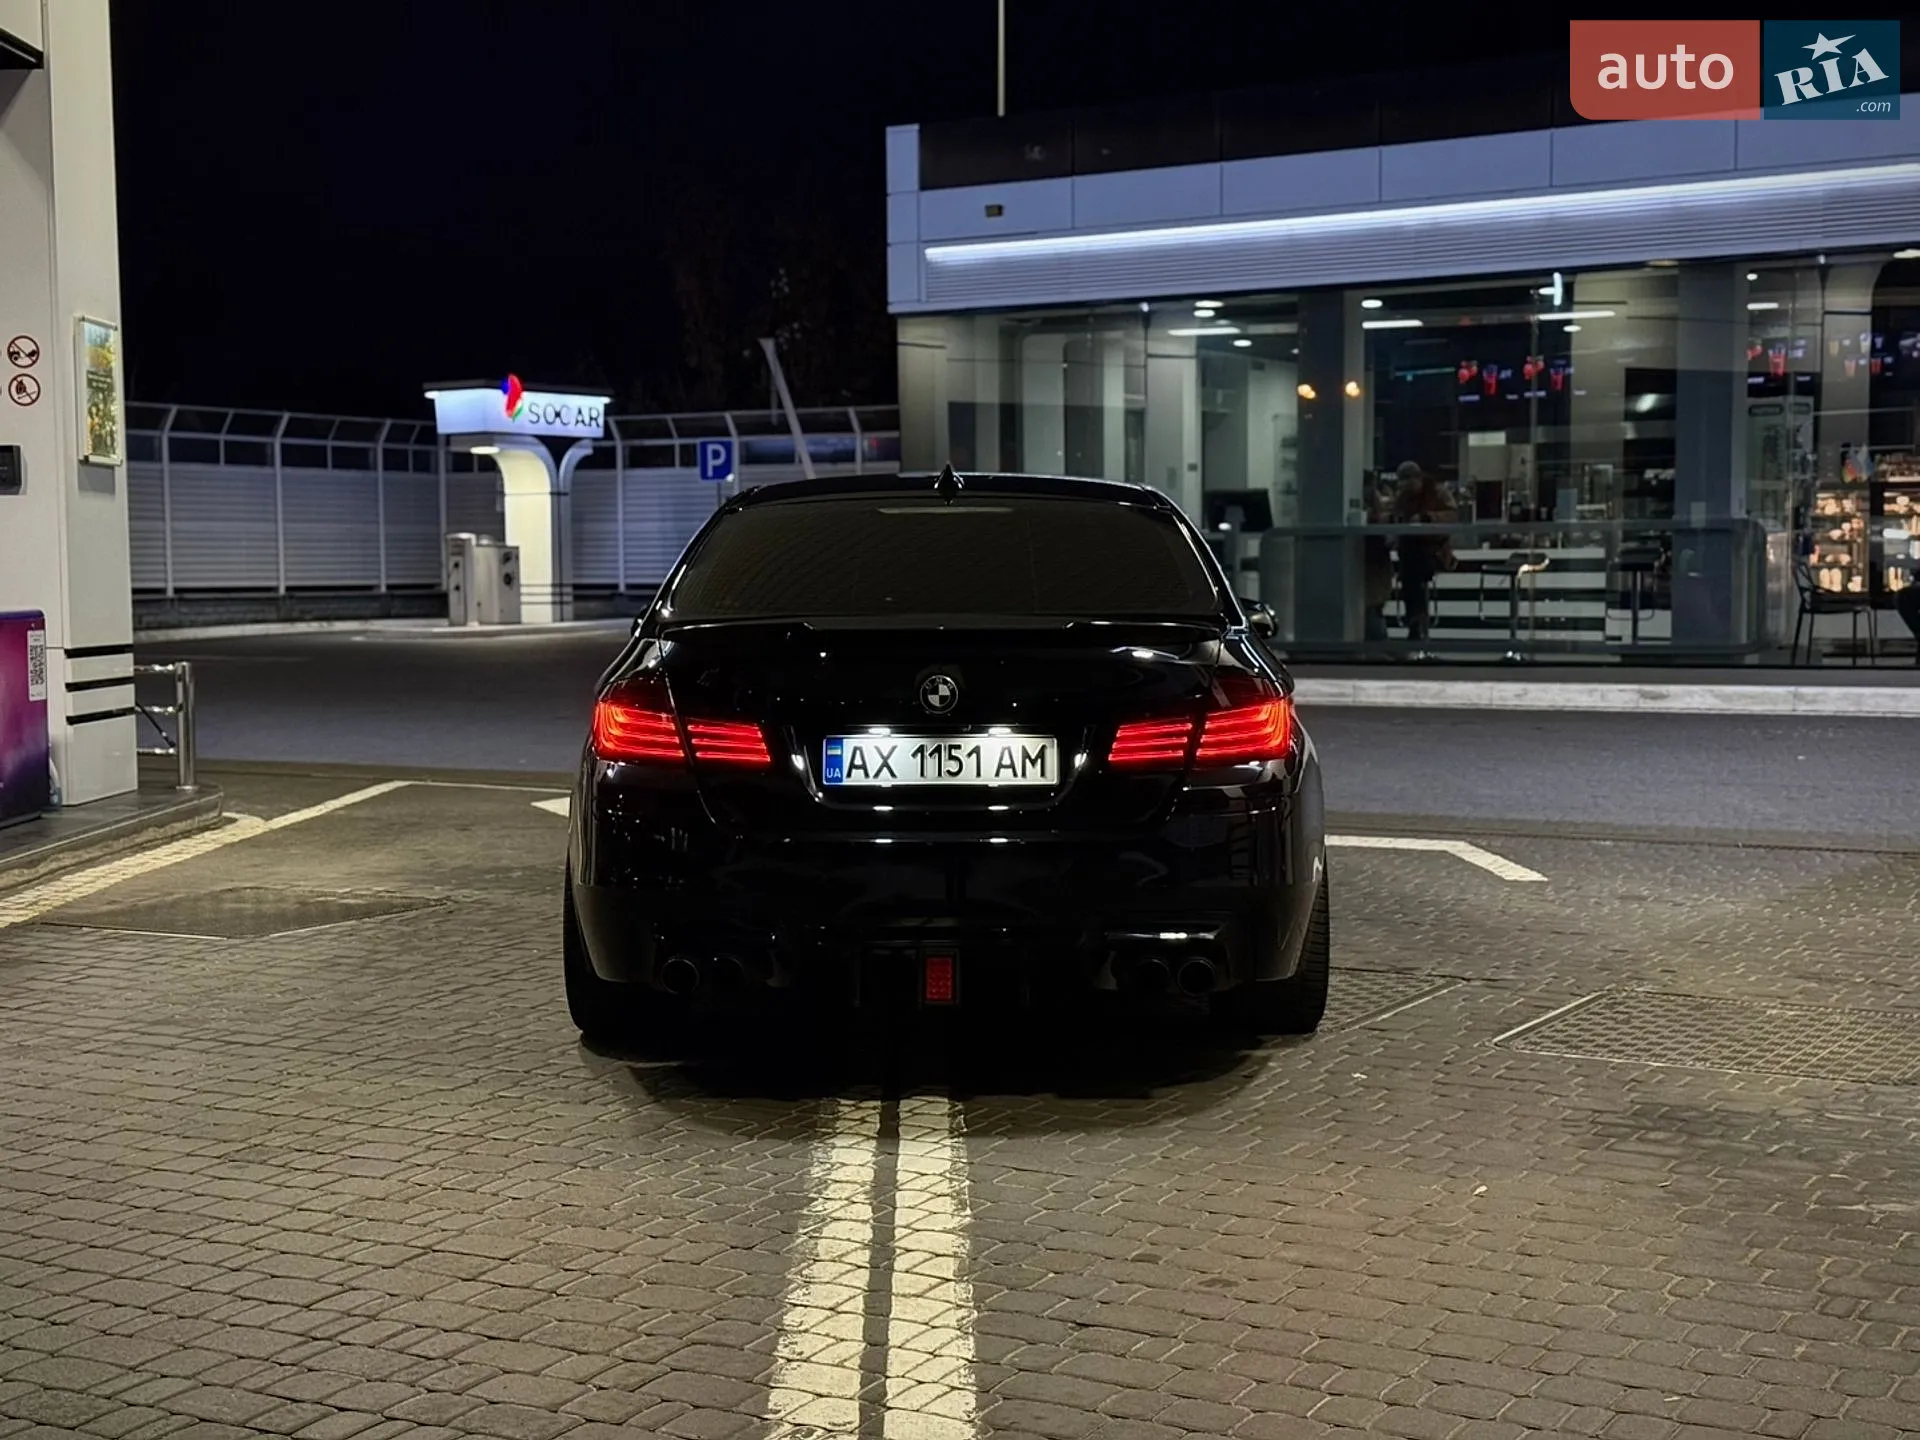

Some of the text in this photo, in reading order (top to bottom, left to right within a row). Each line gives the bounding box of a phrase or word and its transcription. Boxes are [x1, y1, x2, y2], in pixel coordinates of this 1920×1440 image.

[528, 403, 600, 428] SOCAR
[706, 445, 726, 477] P
[826, 767, 842, 779] UA
[846, 743, 1048, 779] AX 1151 AM
